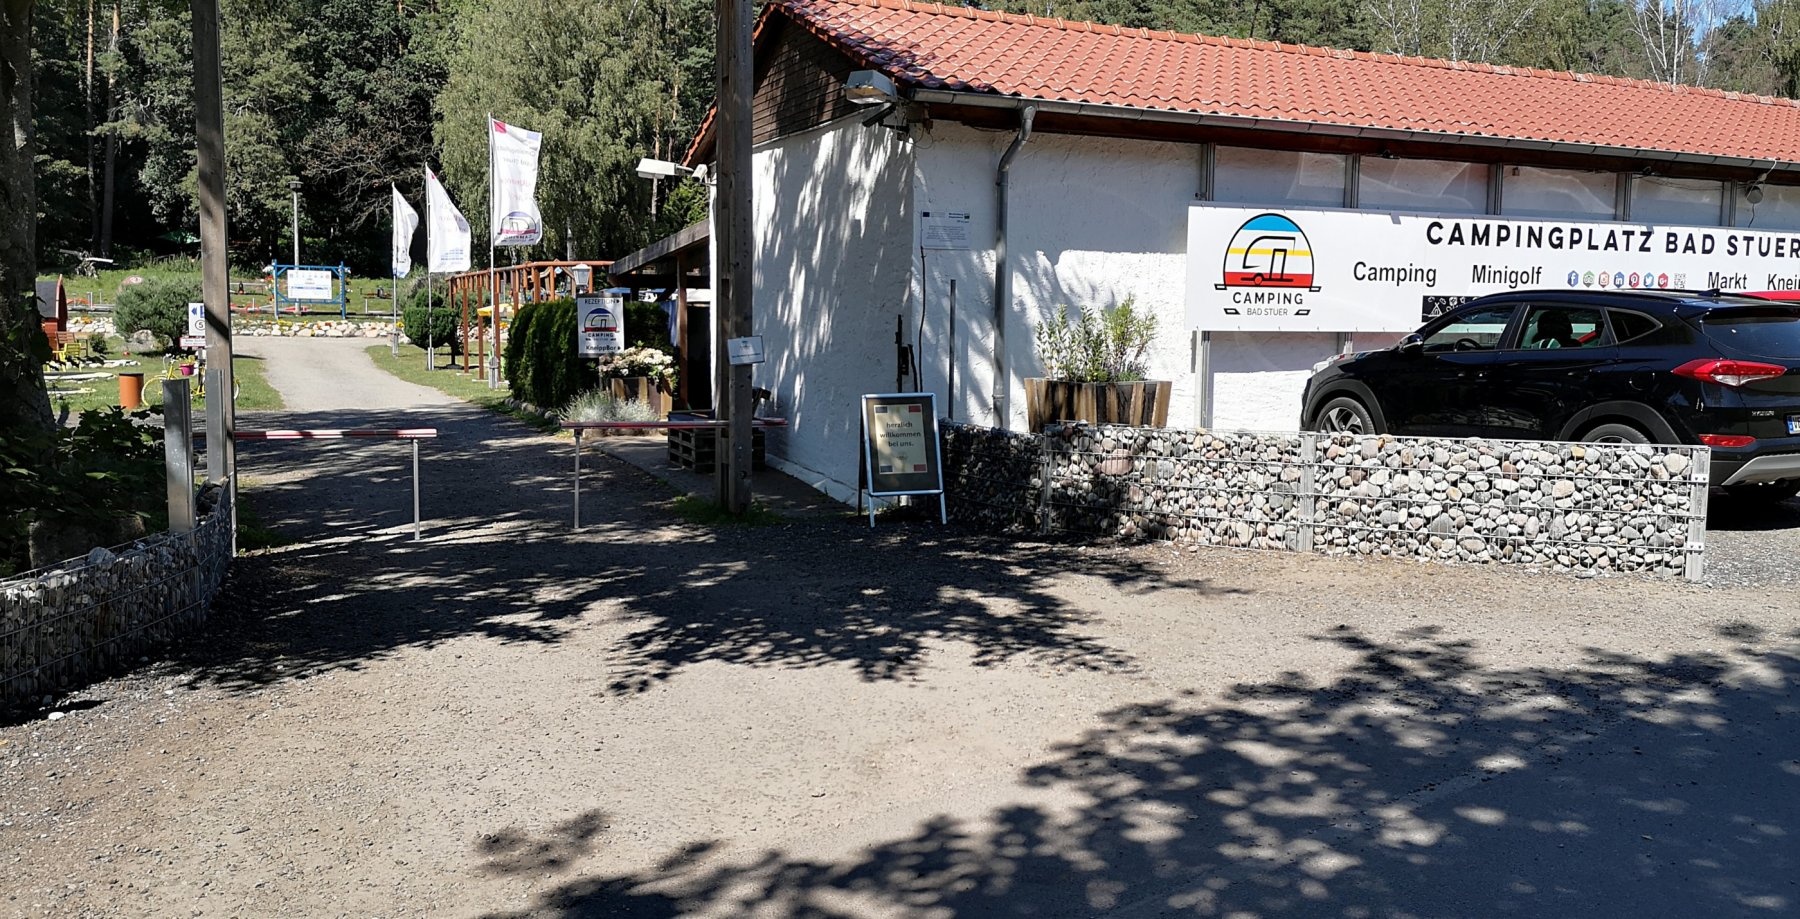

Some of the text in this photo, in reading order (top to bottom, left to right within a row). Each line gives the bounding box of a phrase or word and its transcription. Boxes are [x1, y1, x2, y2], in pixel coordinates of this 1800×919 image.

[1426, 221, 1800, 258] CAMPINGPLATZ BAD STUER
[1353, 261, 1437, 287] Camping
[1472, 265, 1542, 288] Minigolf
[1707, 271, 1748, 290] Markt
[1767, 273, 1800, 291] Knei
[1232, 291, 1304, 305] CAMPING
[1246, 307, 1288, 316] BAD STUER
